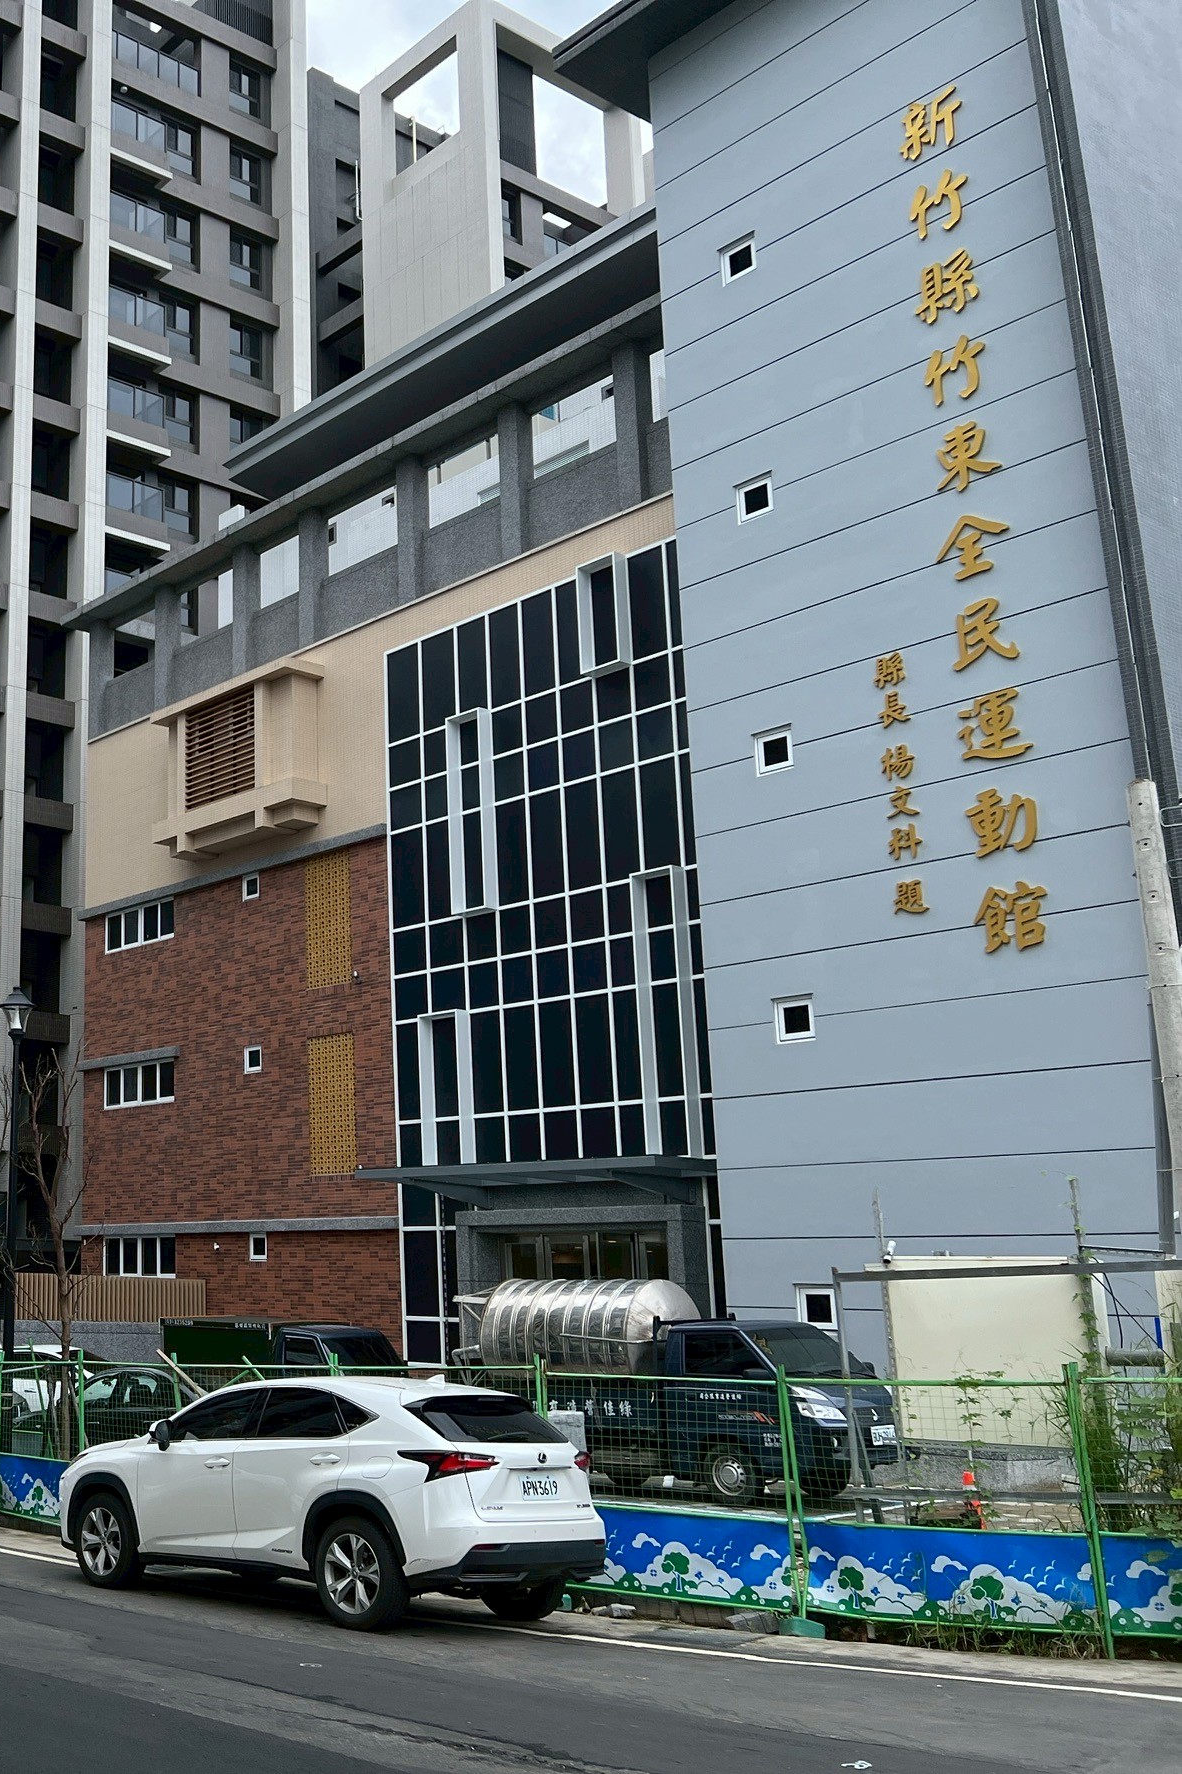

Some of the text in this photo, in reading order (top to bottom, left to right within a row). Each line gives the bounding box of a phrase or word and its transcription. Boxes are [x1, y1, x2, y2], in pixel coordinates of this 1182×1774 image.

[898, 84, 1049, 954] 新竹縣竹東全民運動館
